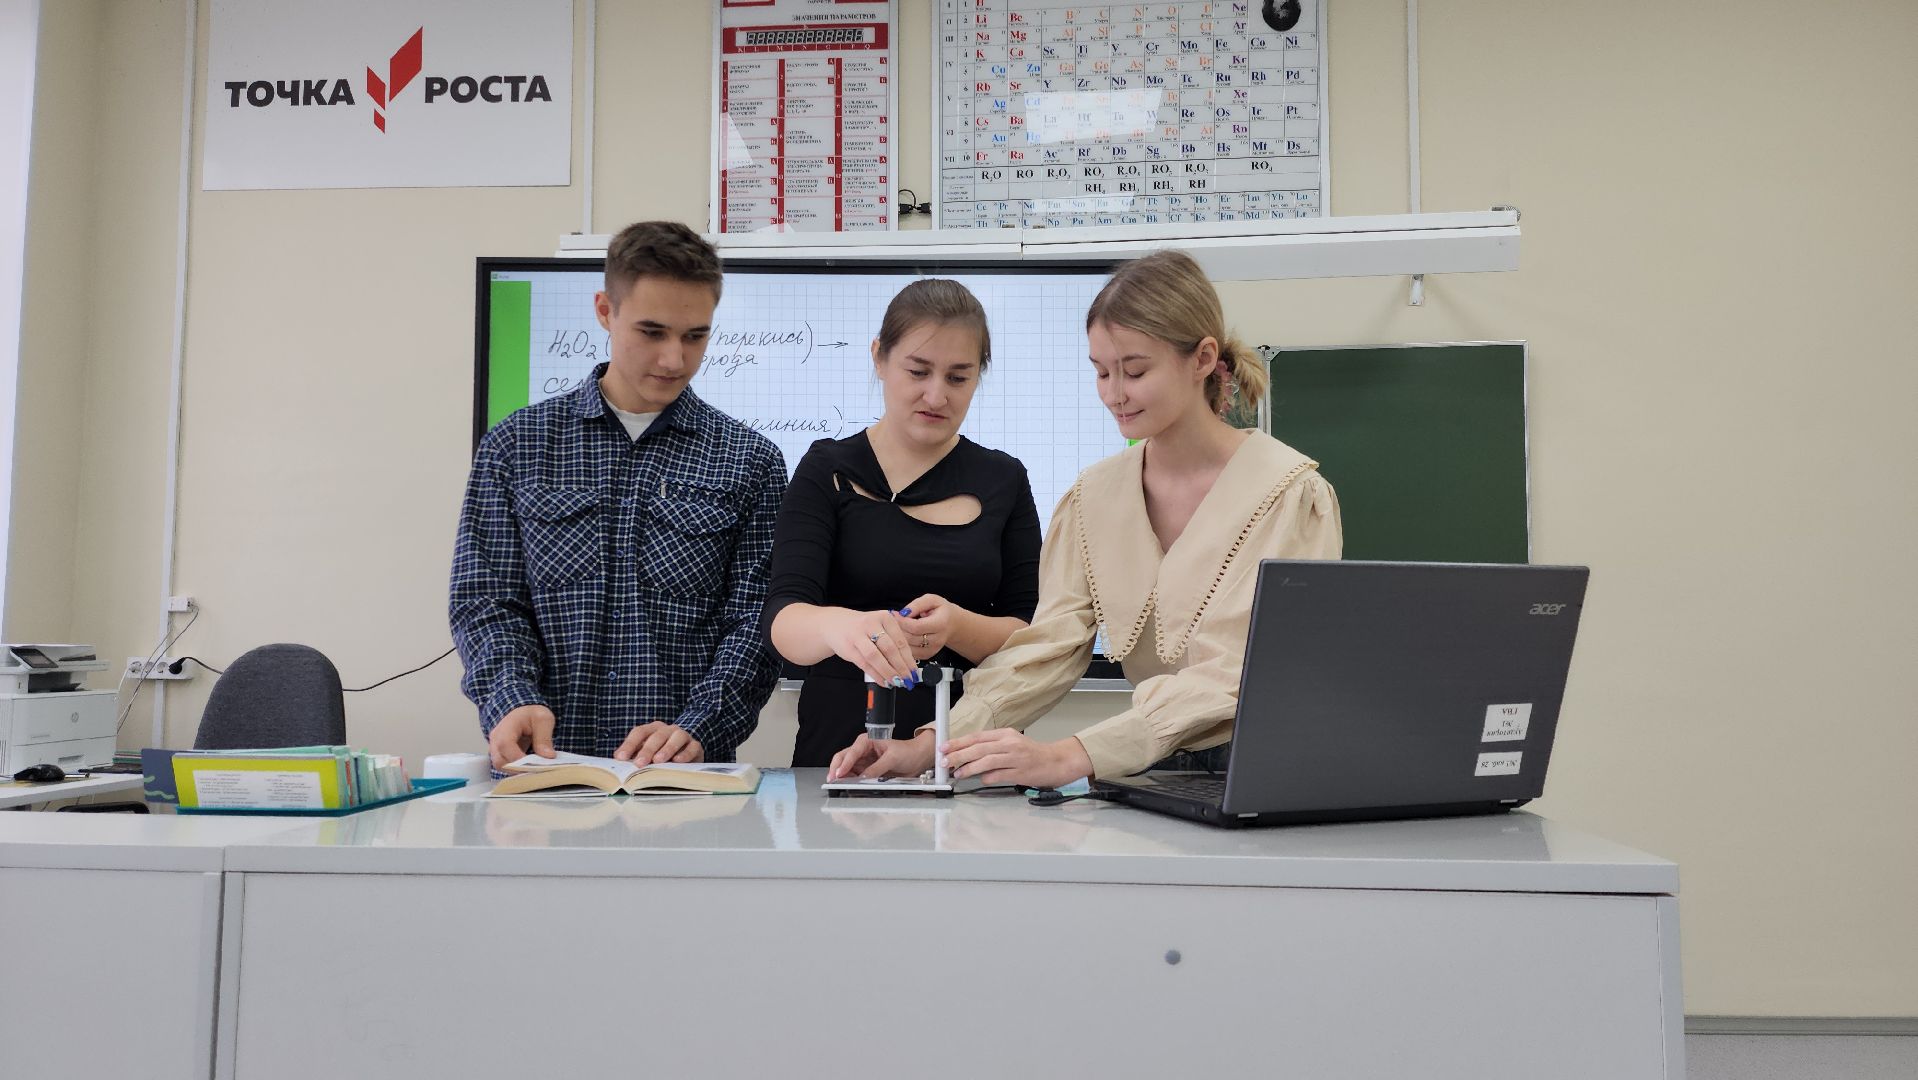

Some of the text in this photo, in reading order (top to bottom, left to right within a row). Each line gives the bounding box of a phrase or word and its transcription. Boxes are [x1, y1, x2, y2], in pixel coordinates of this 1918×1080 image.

[976, 14, 987, 24] Li
[1010, 13, 1023, 22] Be
[1232, 3, 1246, 12] Ne
[976, 32, 990, 40] Na
[1010, 31, 1027, 41] Mg
[1233, 21, 1247, 29] Ar
[976, 50, 984, 58] K
[1010, 48, 1024, 57] Ca
[1077, 45, 1088, 54] Ti
[1111, 44, 1120, 52] V
[1146, 42, 1159, 51] Cr
[1180, 40, 1198, 49] Mn
[1215, 39, 1228, 48] Fe
[1251, 37, 1266, 47] Co
[1285, 36, 1298, 46] Ni
[1026, 64, 1041, 72] Zn
[1232, 55, 1247, 64] Kr
[976, 82, 991, 92] Rb
[1010, 81, 1021, 90] Sr
[1043, 80, 1052, 88] Y
[1077, 78, 1091, 87] Zr
[1111, 76, 1127, 85] Nb
[1146, 75, 1164, 84] Mo
[1216, 73, 1231, 82] Ru
[1251, 72, 1266, 81] Rh
[1286, 70, 1300, 79] Pd
[225, 75, 552, 107] ТОЧКА РОСТА
[993, 99, 1006, 108] Ag
[1233, 89, 1247, 98] Xe
[976, 118, 989, 126] Cs
[1010, 116, 1023, 125] Ba
[1181, 109, 1195, 118] Re
[1216, 107, 1231, 116] Os
[1251, 107, 1262, 115] Ir
[1286, 106, 1298, 114] Pt
[992, 134, 1007, 142] Au
[1232, 125, 1248, 134] Rn
[976, 152, 988, 160] Fr
[1010, 151, 1024, 160] Ra
[1044, 150, 1058, 158] Ac
[1078, 148, 1091, 157] Rf
[1112, 147, 1127, 155] Db
[1146, 145, 1160, 155] Sg
[1182, 144, 1195, 153] Bh
[1217, 143, 1231, 151] Hs
[1252, 142, 1267, 151] Mt
[1287, 141, 1301, 150] Ds
[1016, 170, 1034, 178] RO
[1189, 180, 1206, 189] RH
[1271, 193, 1284, 201] Yb
[1246, 211, 1260, 220] Md
[1271, 211, 1283, 219] No
[1528, 603, 1566, 615] acer
